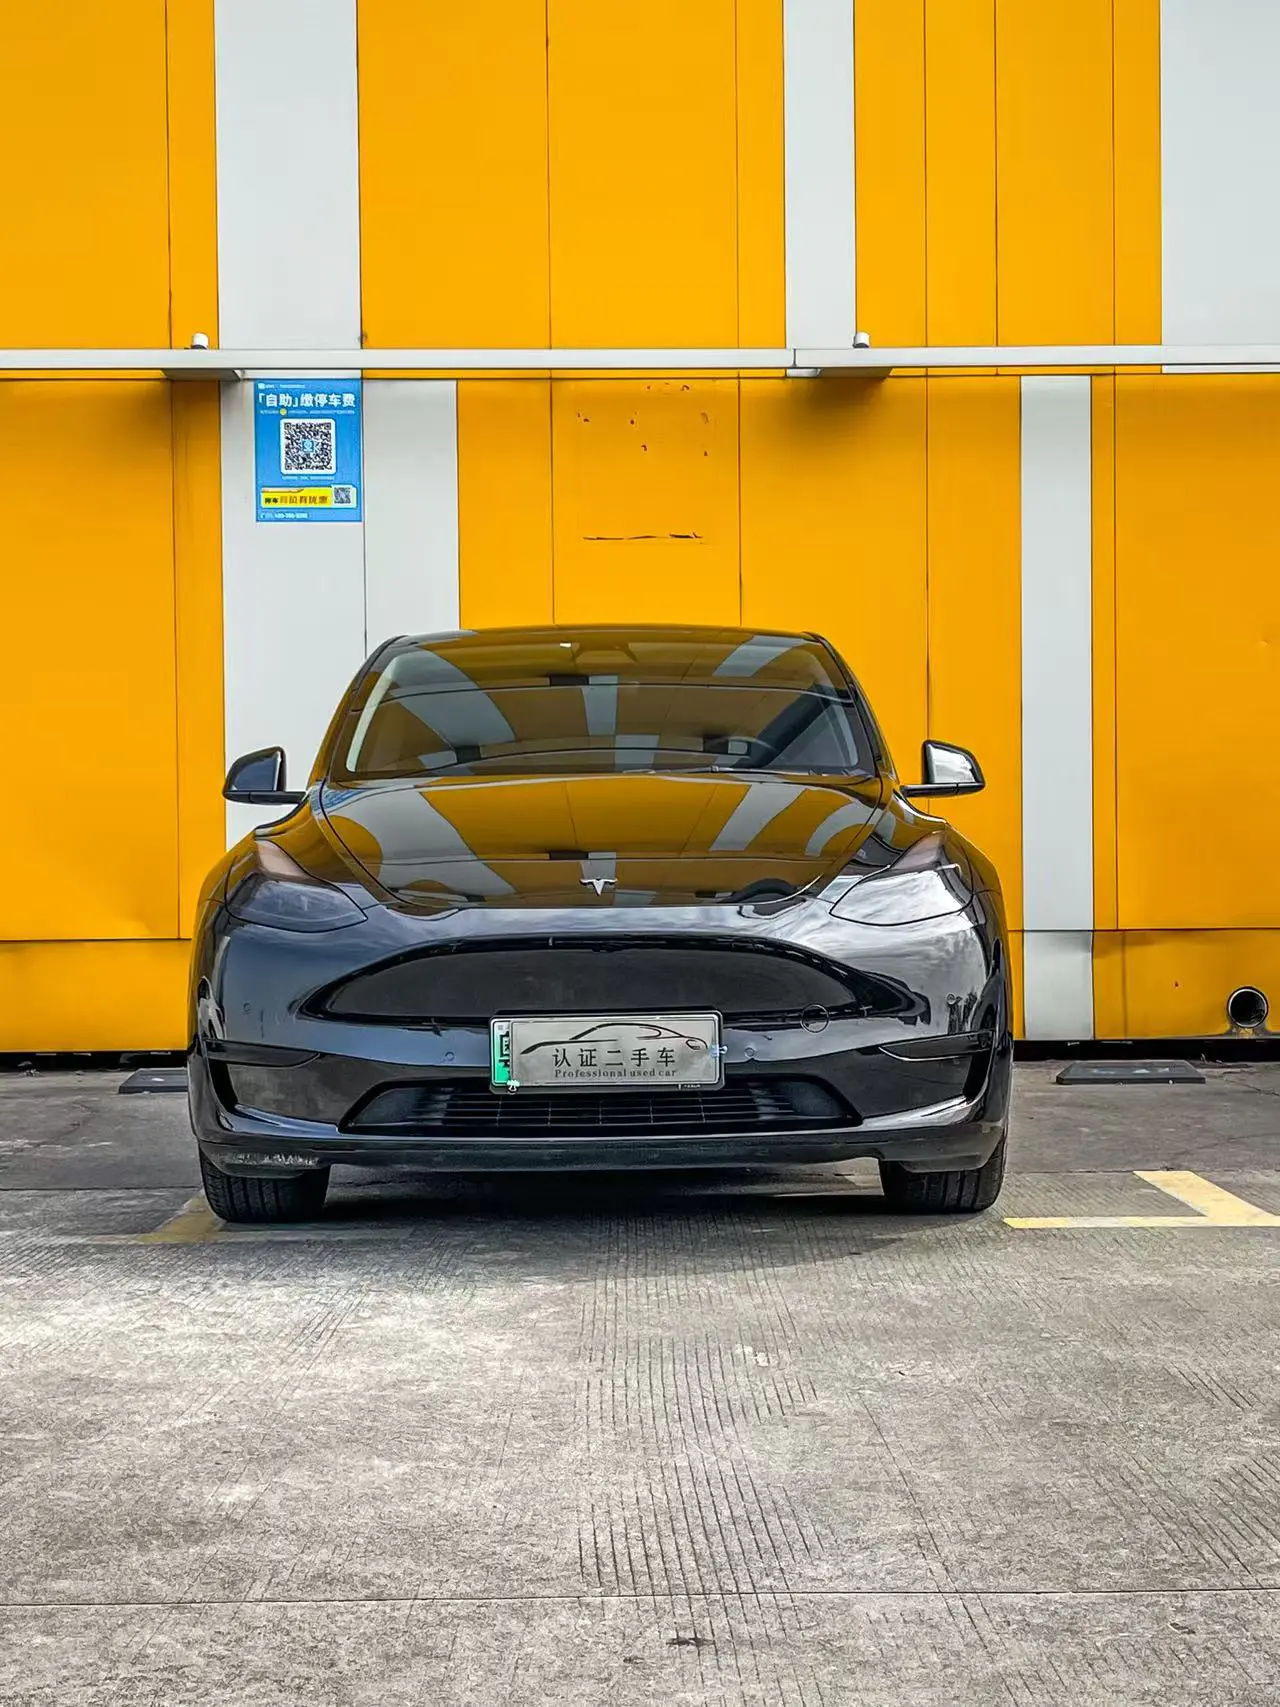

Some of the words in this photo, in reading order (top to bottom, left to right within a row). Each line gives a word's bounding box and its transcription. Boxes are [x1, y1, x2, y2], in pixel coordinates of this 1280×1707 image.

[552, 1047, 676, 1067] 认证二手车
[555, 1068, 627, 1078] Professional
[629, 1068, 656, 1078] used
[658, 1070, 678, 1078] car
